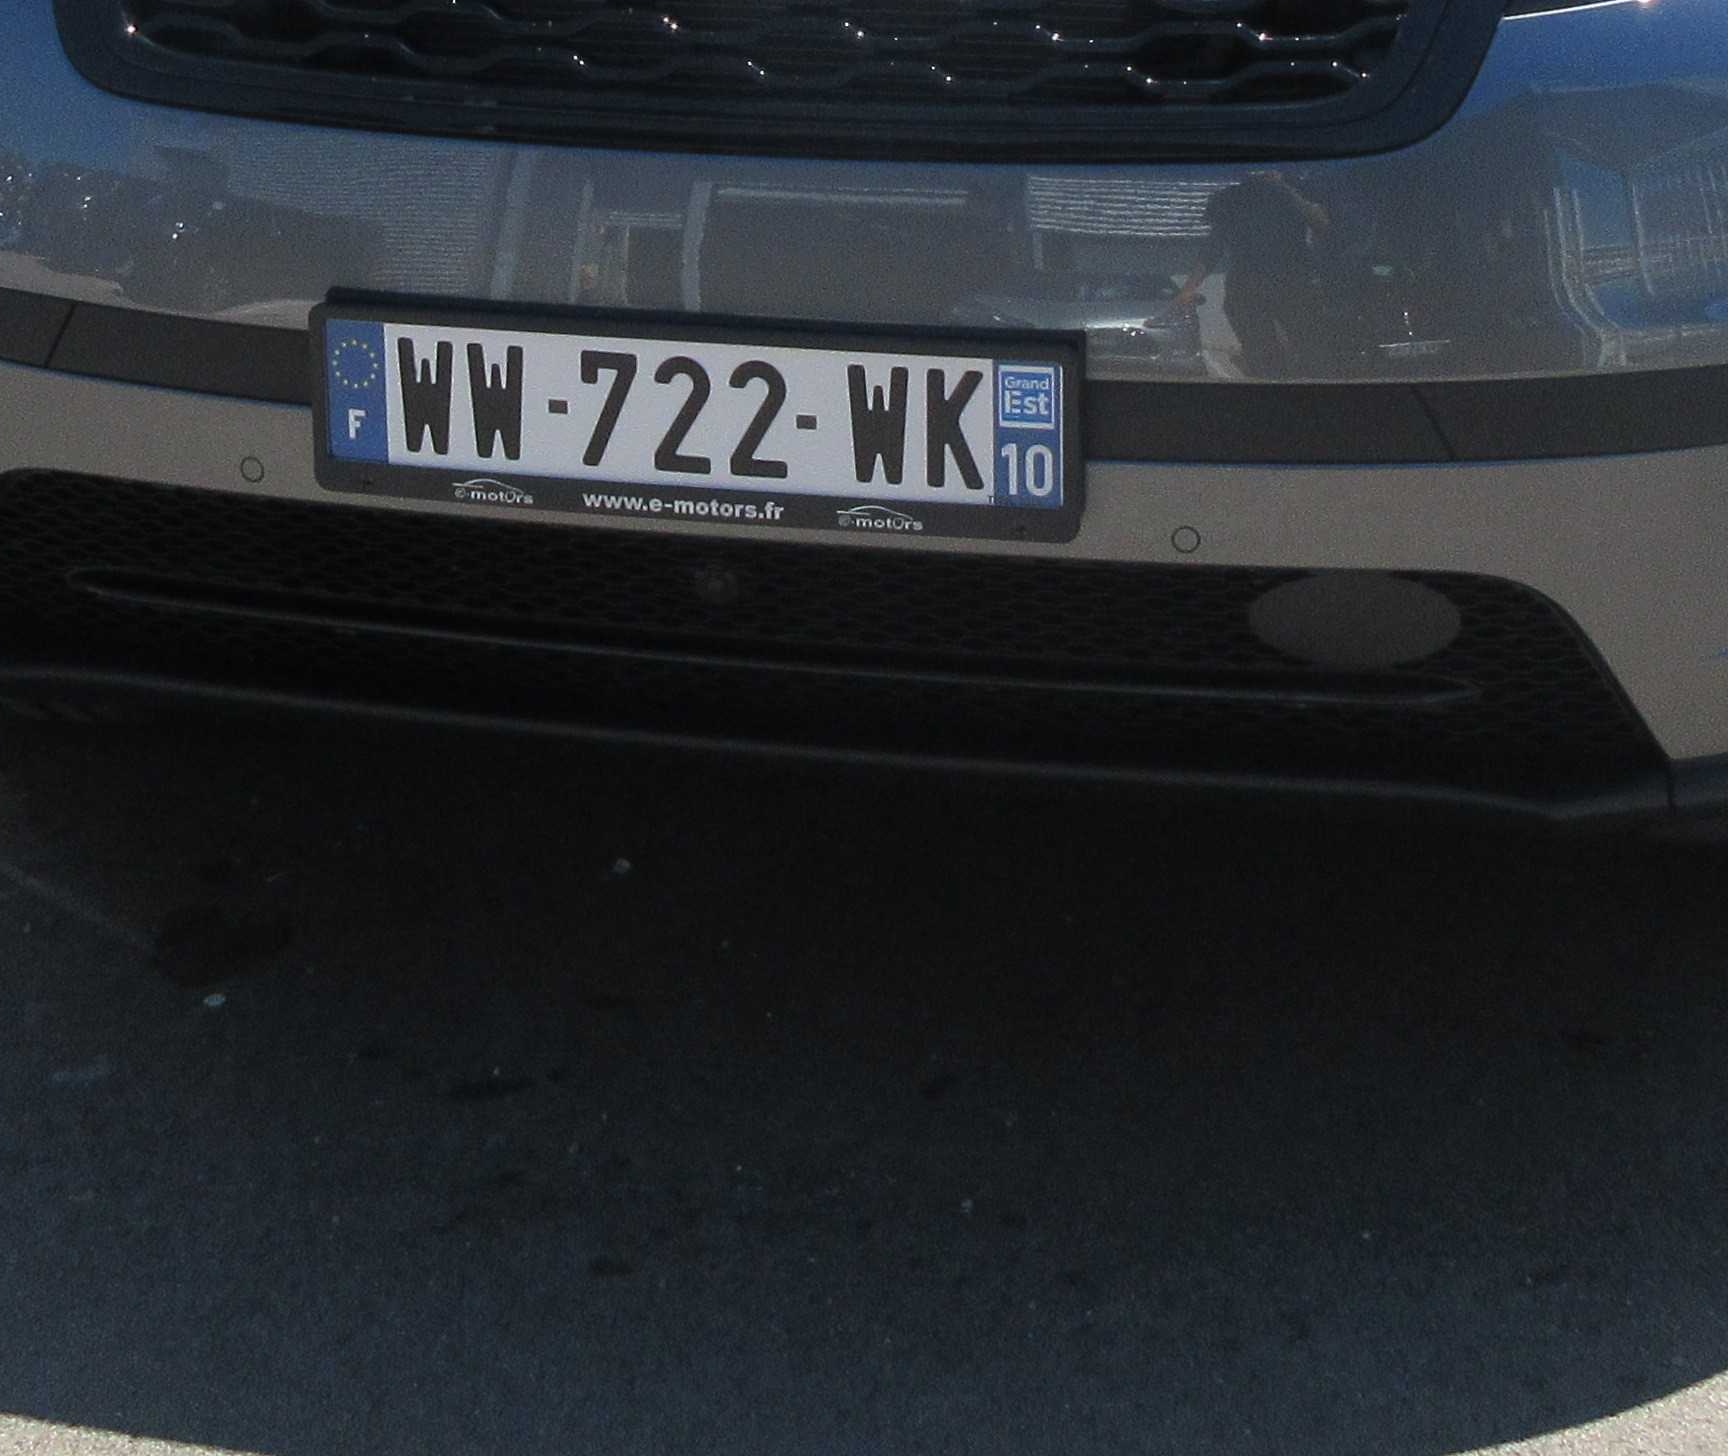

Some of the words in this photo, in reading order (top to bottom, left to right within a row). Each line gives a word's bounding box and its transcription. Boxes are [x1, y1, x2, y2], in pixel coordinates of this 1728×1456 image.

[1004, 376, 1050, 390] Grand
[1004, 390, 1050, 416] Est
[347, 408, 367, 441] F
[1001, 443, 1054, 497] 10
[582, 490, 785, 521] www.e-motors.fr
